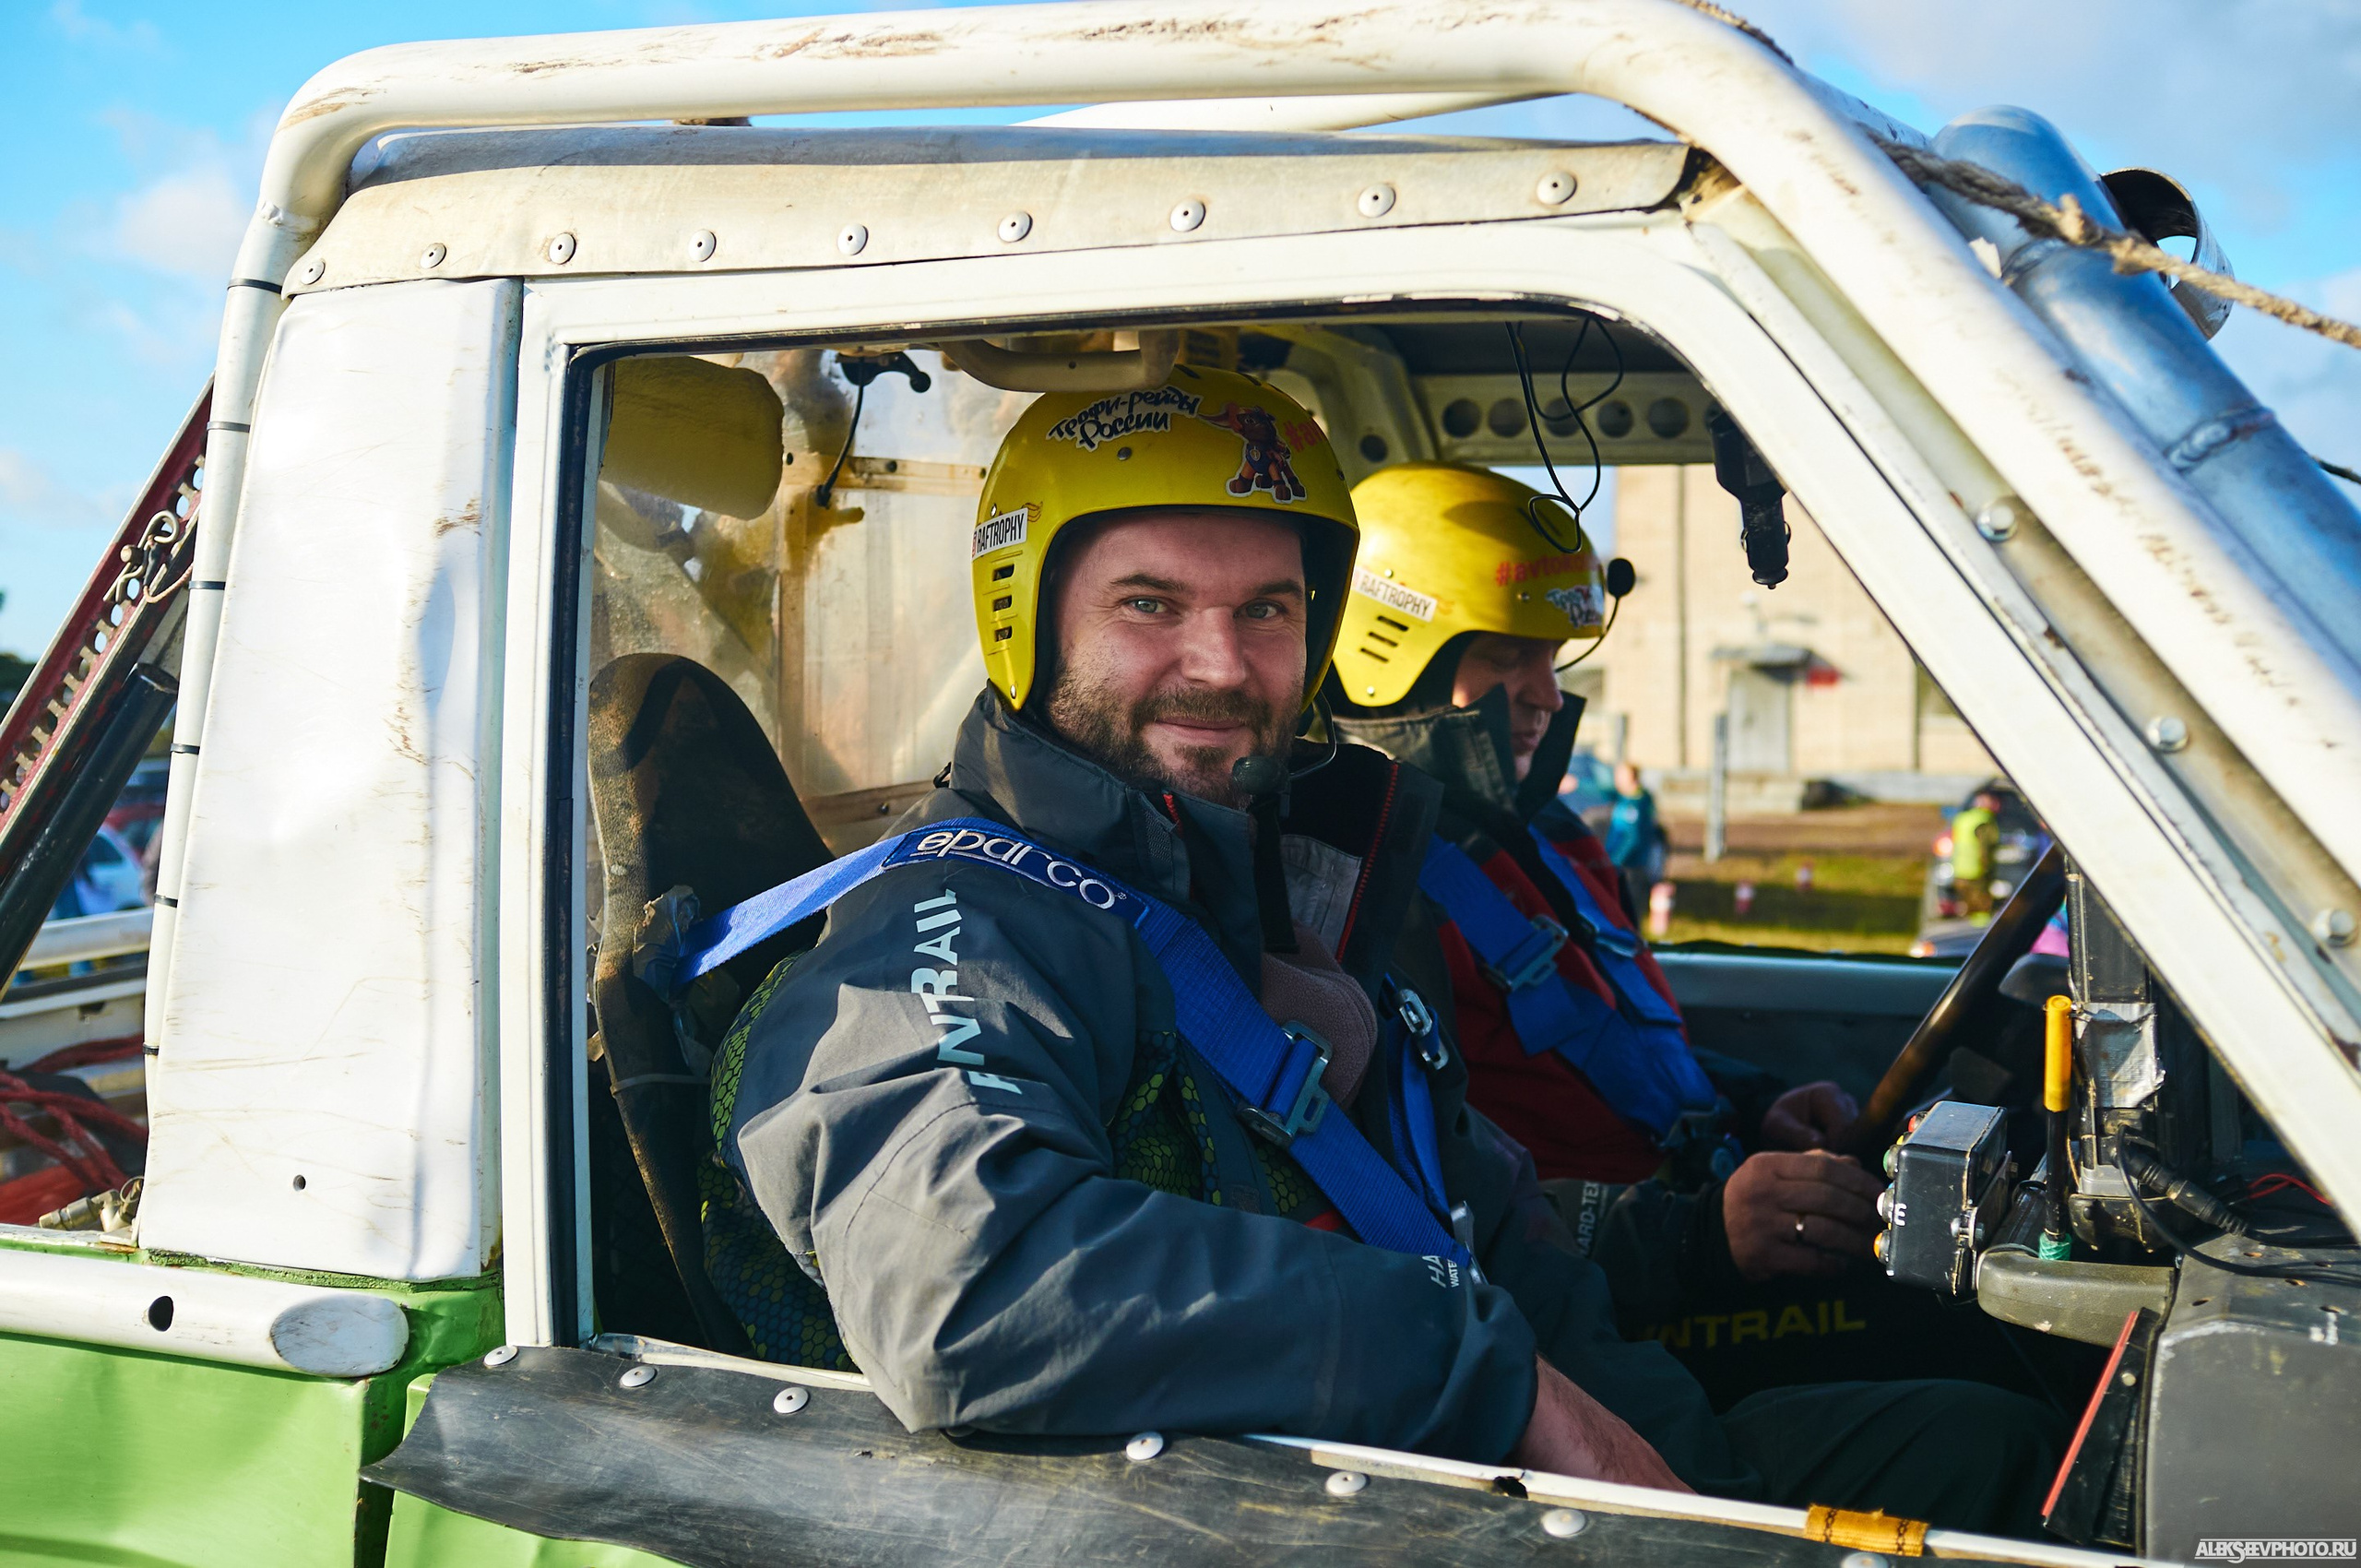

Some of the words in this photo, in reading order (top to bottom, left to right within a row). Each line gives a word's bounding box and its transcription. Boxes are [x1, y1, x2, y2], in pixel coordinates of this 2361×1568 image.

[1078, 411, 1169, 449] России
[977, 513, 1025, 553] RAFTROPHY
[1358, 574, 1431, 618] RAFTROPHY
